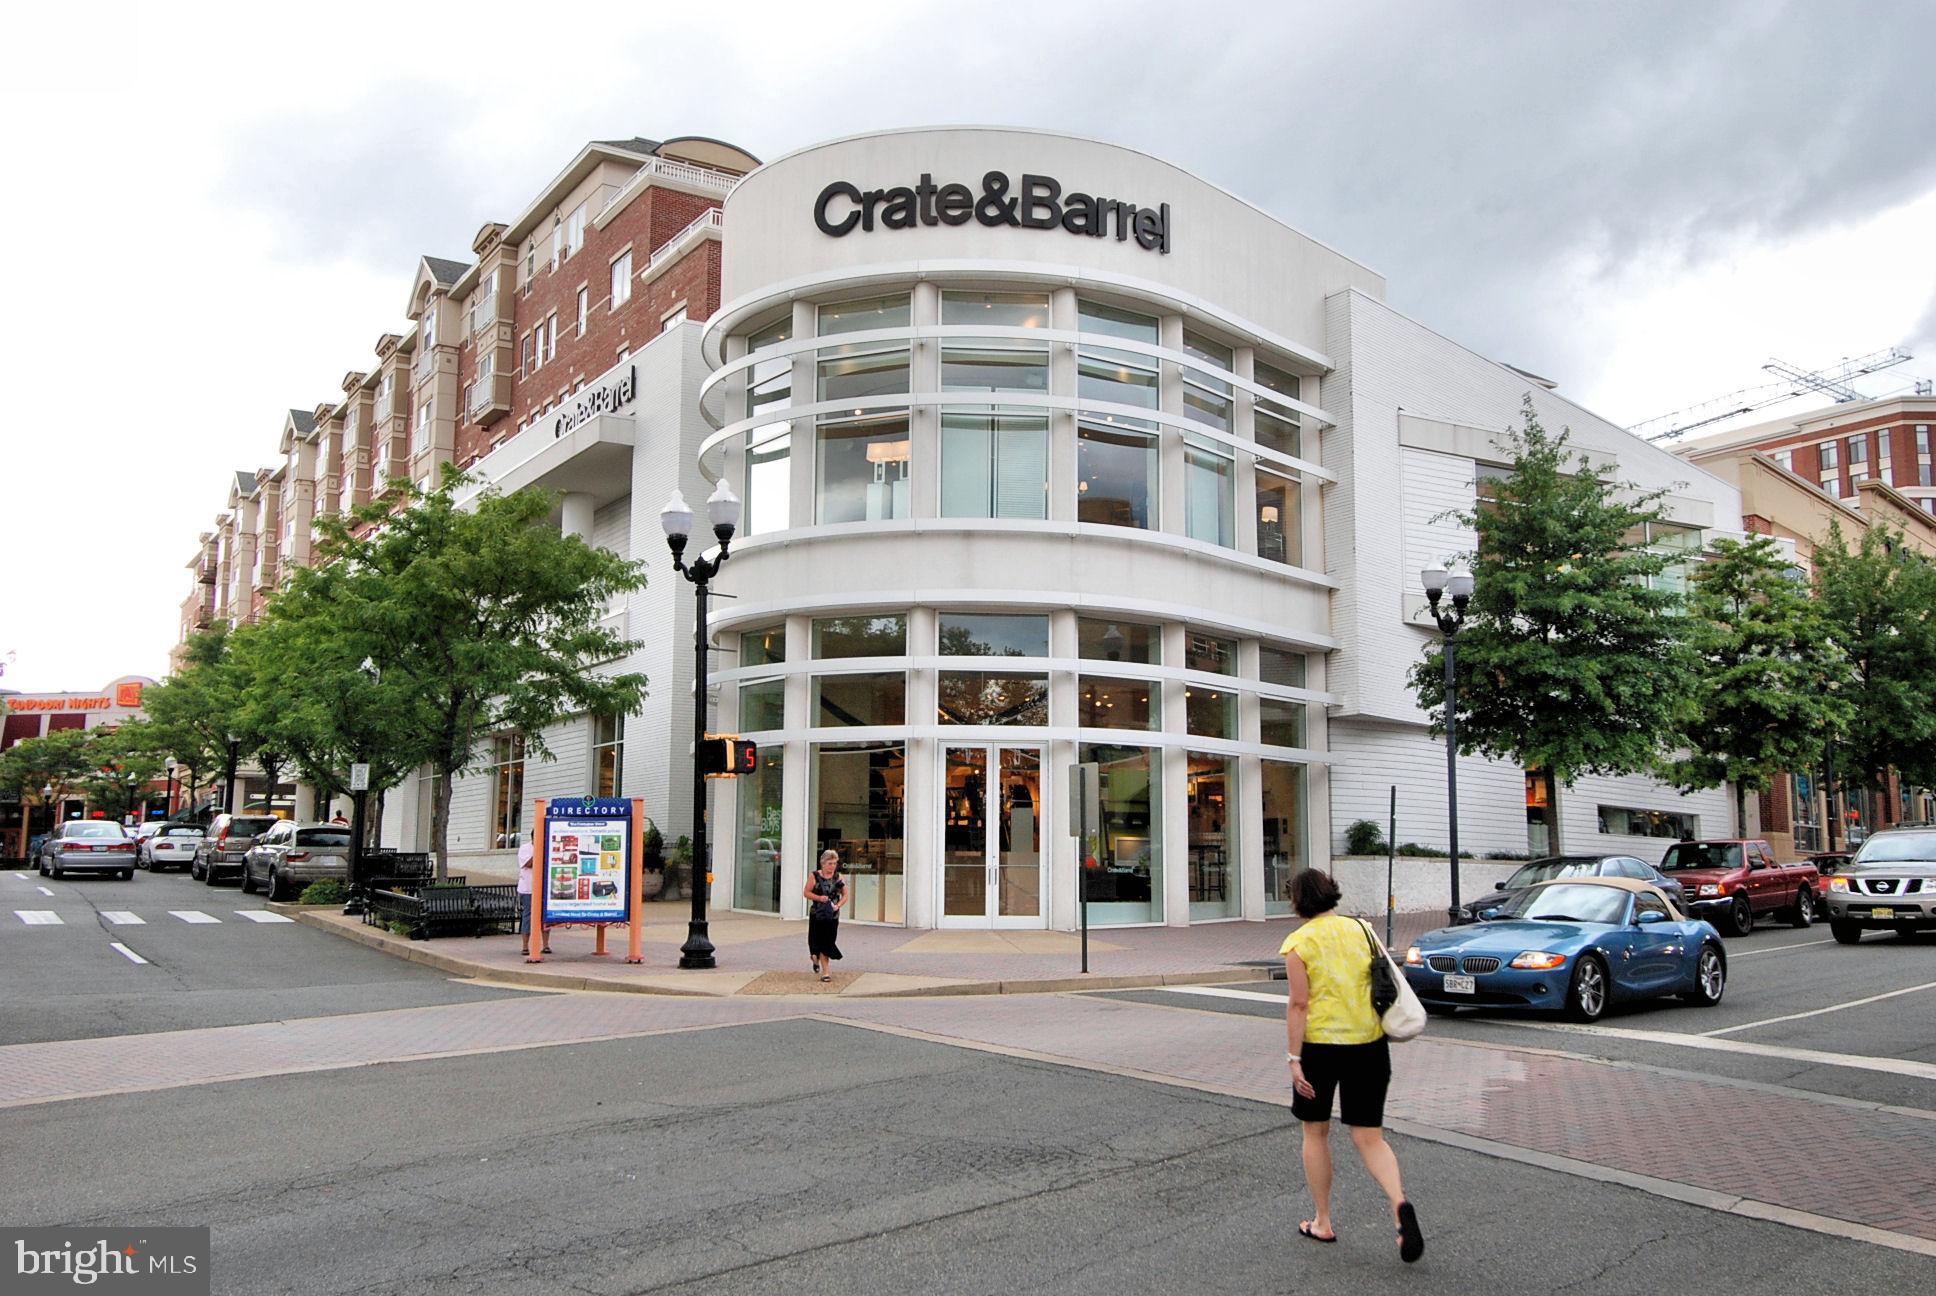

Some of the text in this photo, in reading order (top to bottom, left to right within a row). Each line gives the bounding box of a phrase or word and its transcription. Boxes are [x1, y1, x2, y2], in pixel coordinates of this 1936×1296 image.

[813, 170, 1170, 255] Crate&Barrel
[69, 697, 111, 709] NIGHTS
[746, 748, 754, 767] 5
[553, 807, 625, 815] DIRECTORY
